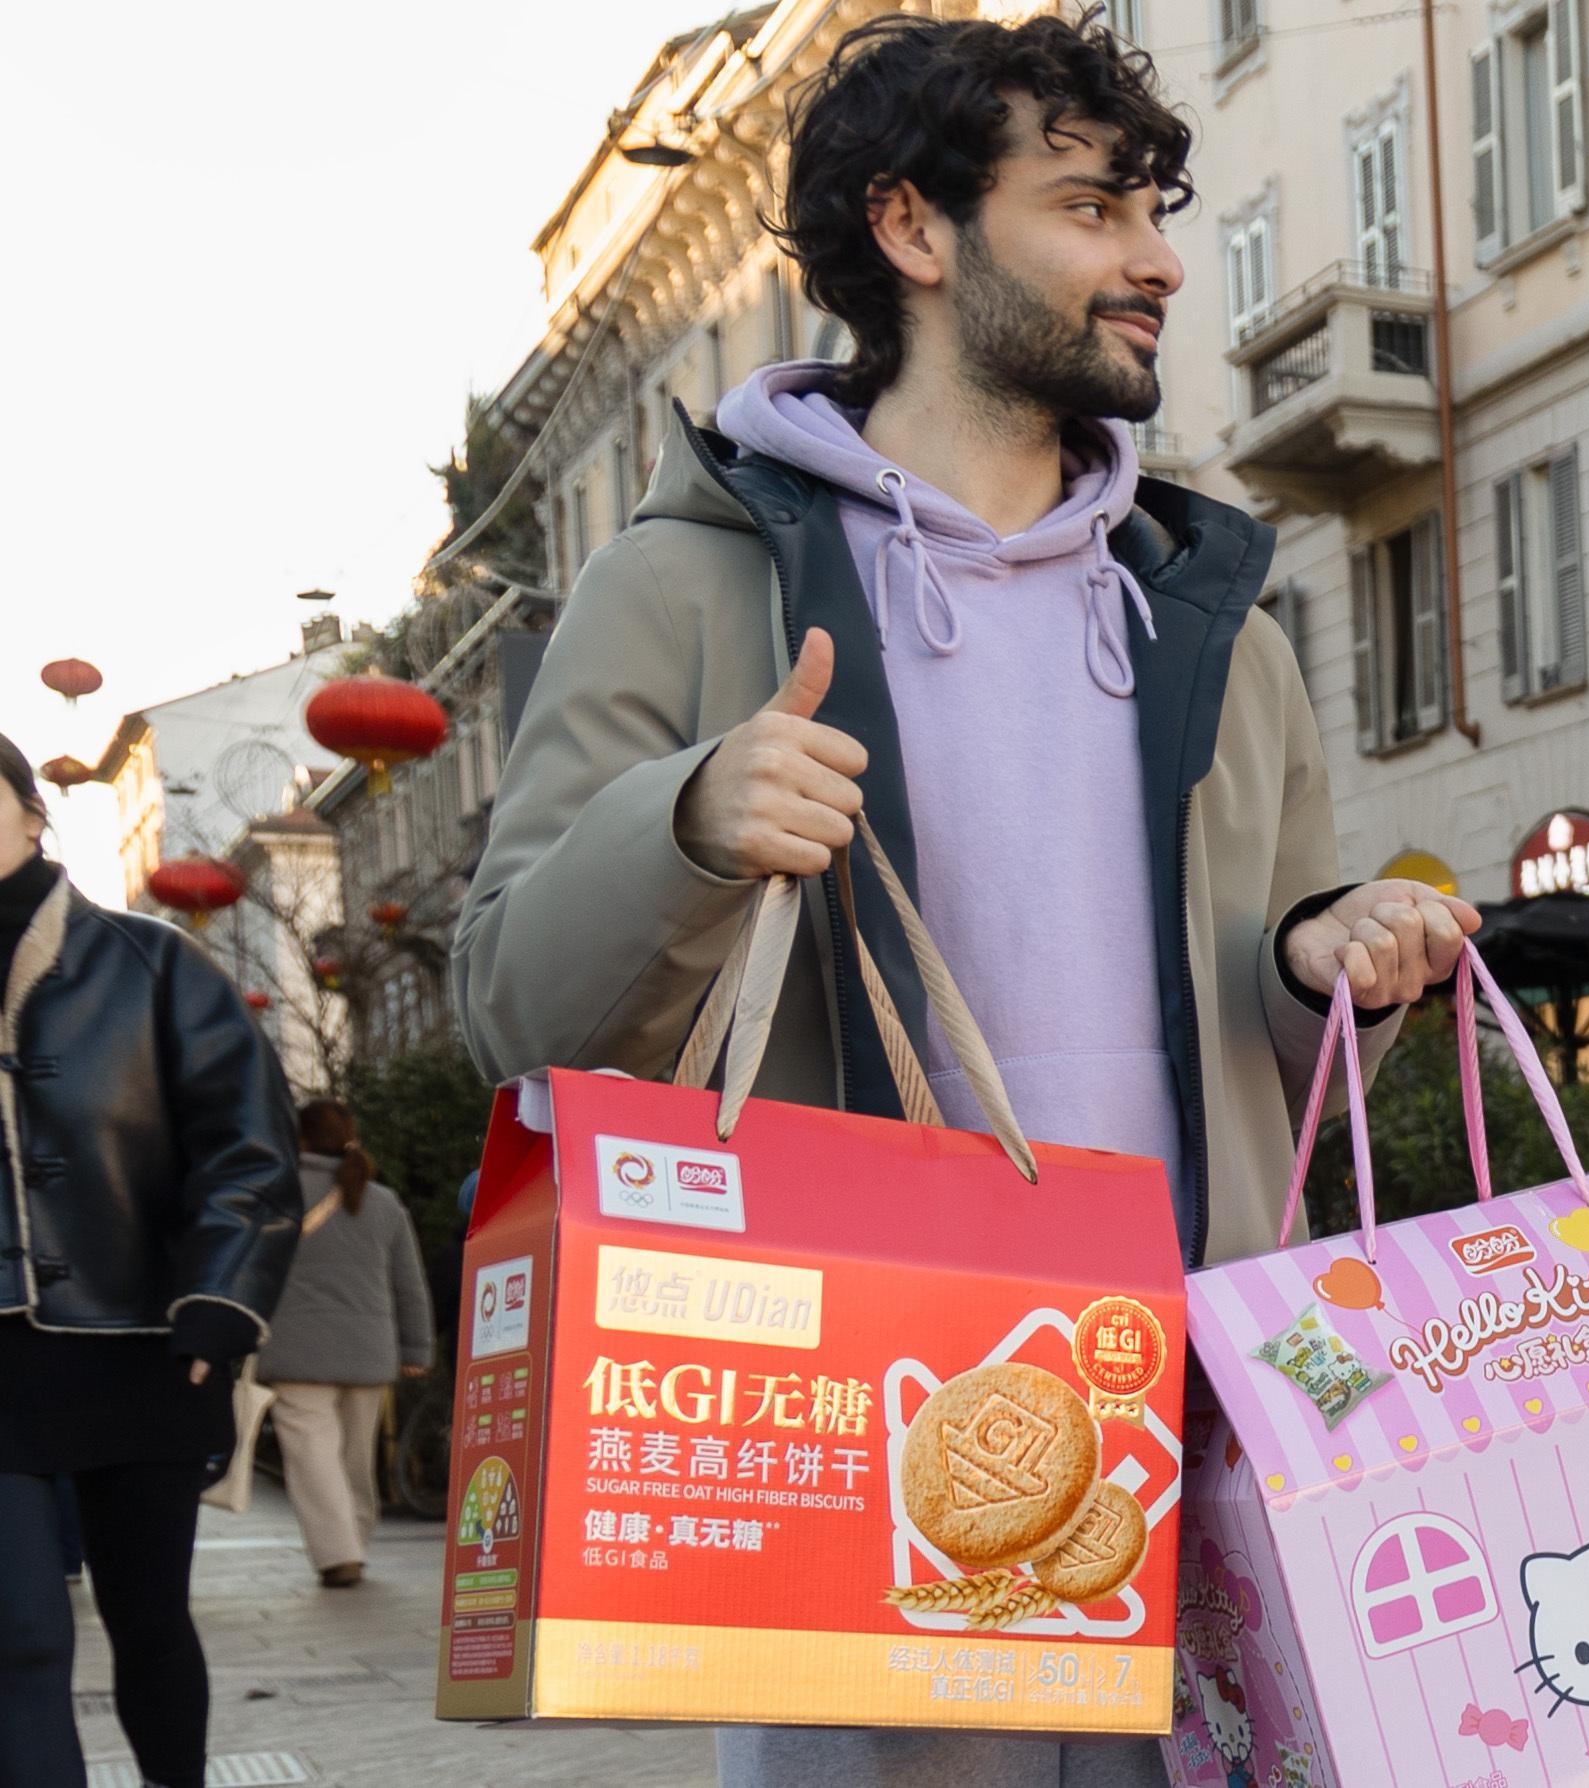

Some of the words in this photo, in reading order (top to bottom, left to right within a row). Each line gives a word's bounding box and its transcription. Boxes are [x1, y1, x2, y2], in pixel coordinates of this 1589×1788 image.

[608, 1265, 690, 1321] 悠点
[702, 1279, 813, 1331] UDian
[1390, 1291, 1526, 1393] Hello
[588, 1426, 870, 1490] 燕麦高纤饼干
[586, 1477, 640, 1495] SUGAR
[642, 1481, 680, 1498] FREE
[683, 1485, 714, 1501] OAT
[716, 1487, 754, 1503] HIGH
[757, 1491, 798, 1507] FIBER
[800, 1493, 865, 1512] BISCUITS
[583, 1547, 669, 1571] 低GI食品
[888, 1644, 1016, 1674] 经过人体测试
[930, 1675, 1015, 1701] 真正低GI
